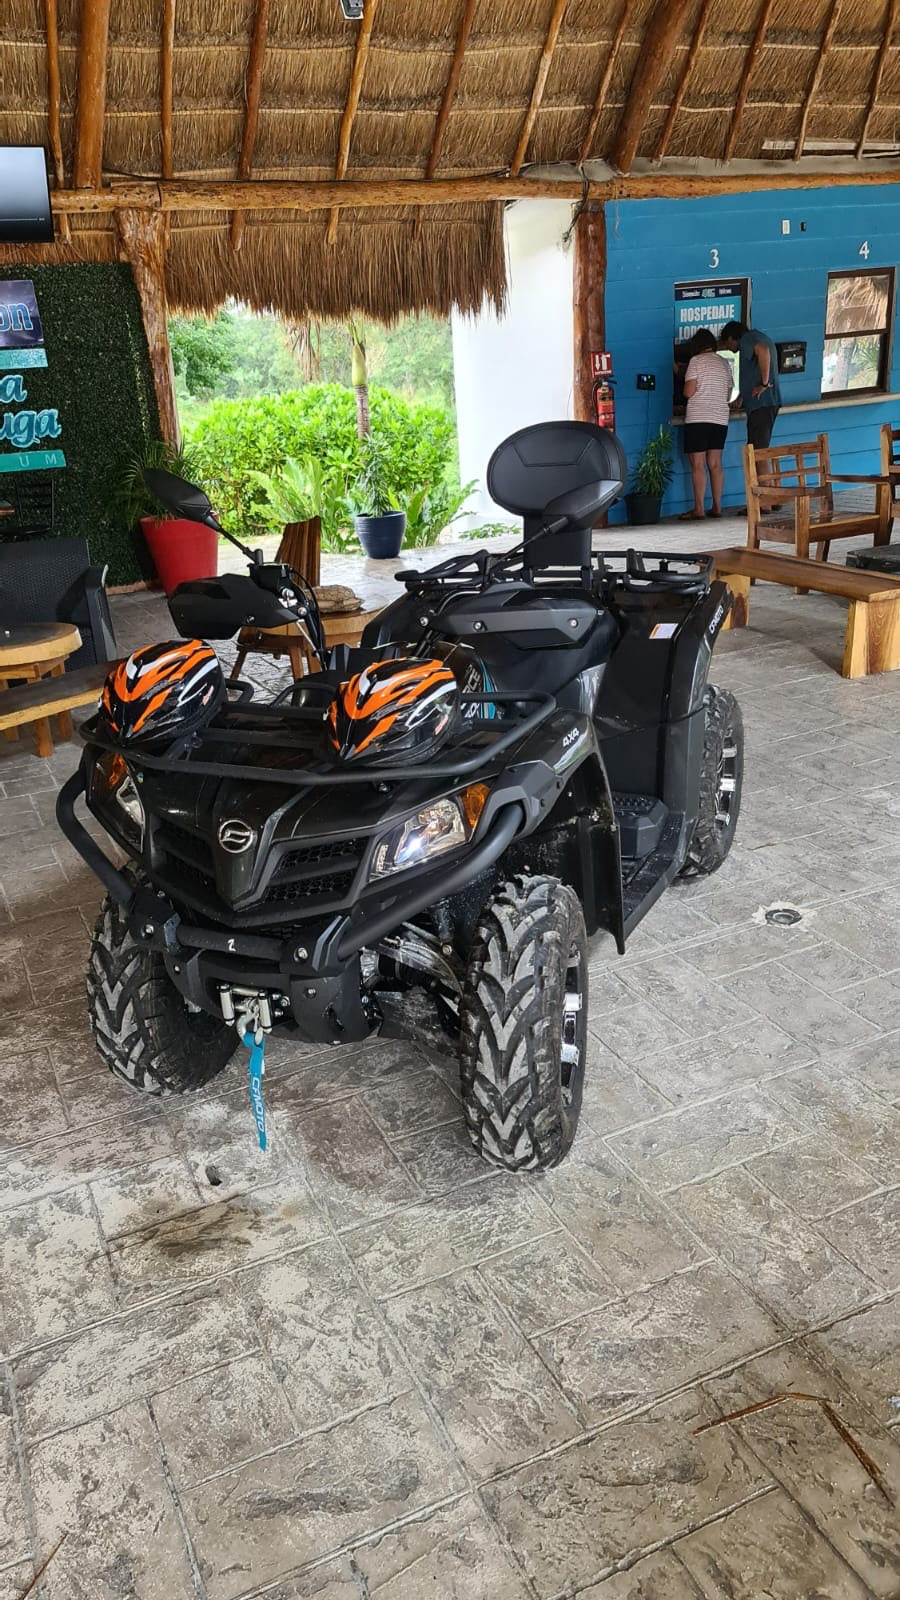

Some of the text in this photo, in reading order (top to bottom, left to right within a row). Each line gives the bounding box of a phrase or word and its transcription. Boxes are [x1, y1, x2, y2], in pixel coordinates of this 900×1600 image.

[708, 249, 719, 268] 3
[859, 241, 869, 259] 4
[680, 304, 735, 322] HOSPEDAJE
[252, 1077, 264, 1132] CFMOTO
